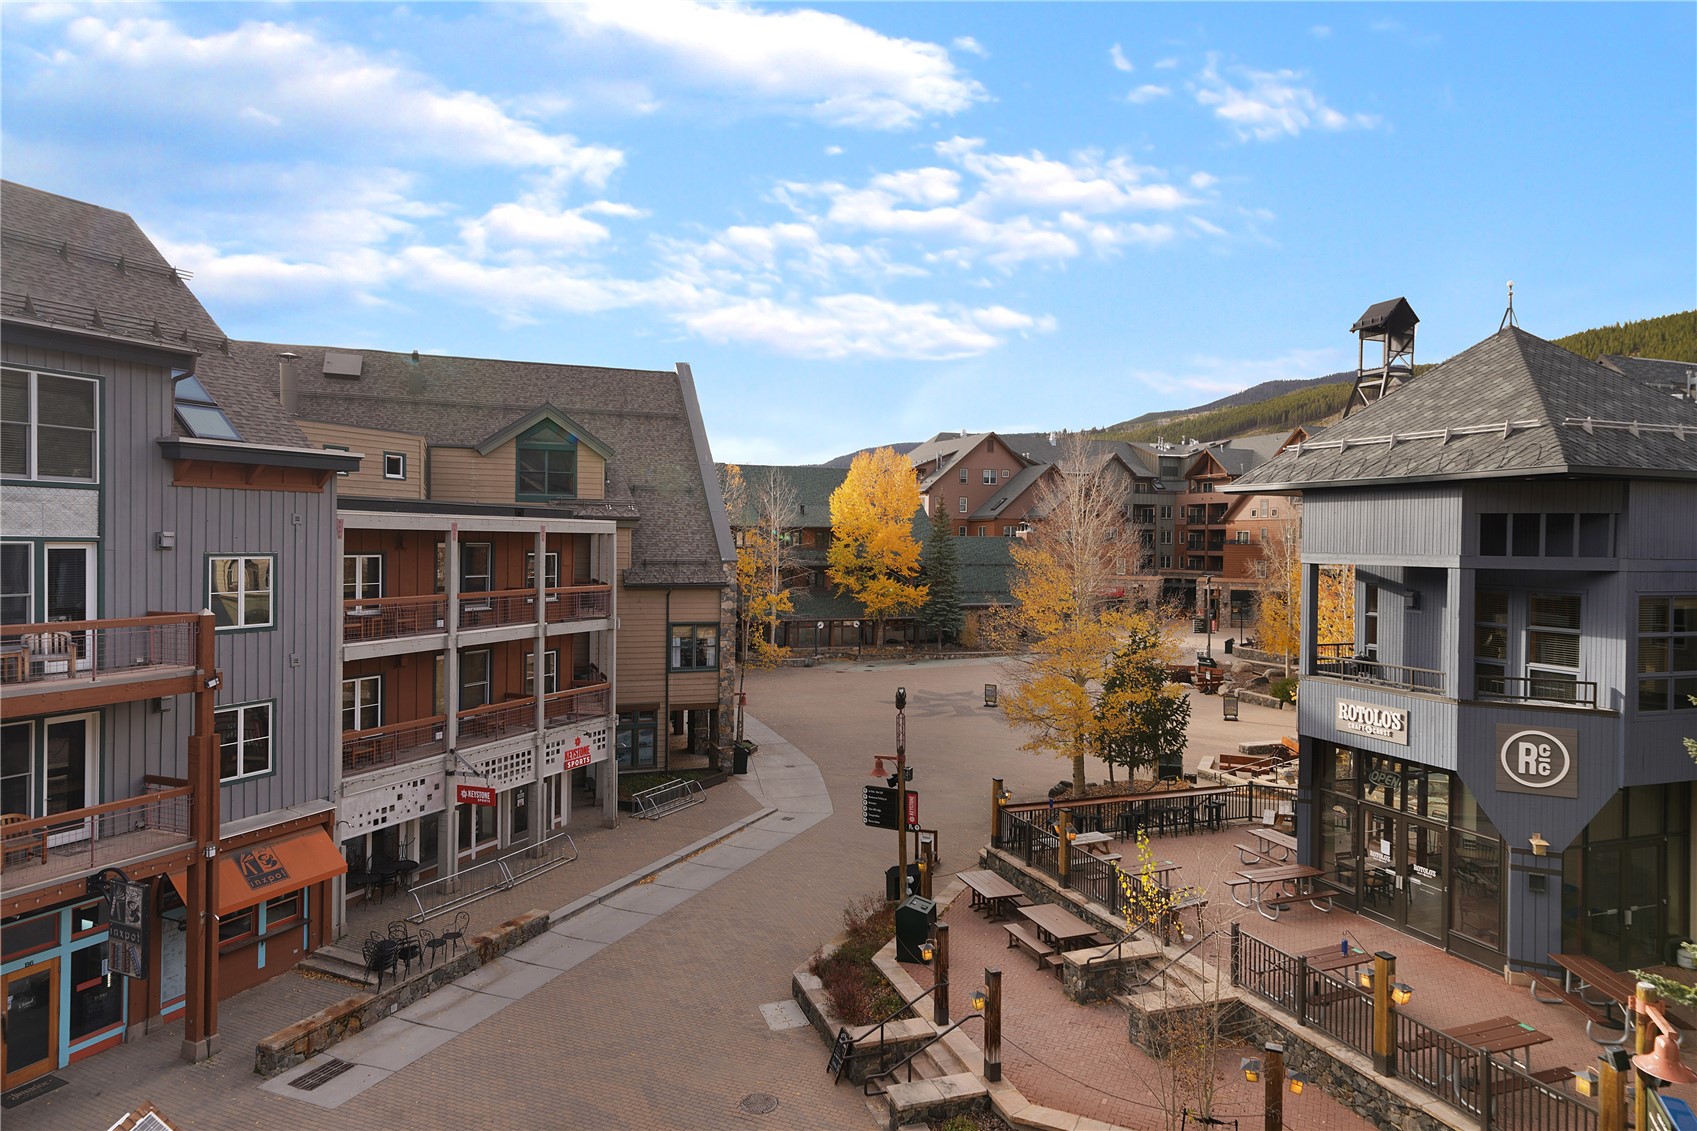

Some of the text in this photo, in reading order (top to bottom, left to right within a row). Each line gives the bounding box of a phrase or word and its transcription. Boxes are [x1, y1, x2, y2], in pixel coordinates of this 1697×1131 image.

[1338, 702, 1402, 731] ROTOLO'S
[1348, 722, 1365, 732] CRAFT
[564, 745, 591, 761] KEYSTONE
[567, 756, 591, 769] SPORTS
[1371, 770, 1400, 787] OPEN
[467, 790, 491, 800] KEYSTONE
[247, 869, 287, 888] inxpot
[109, 923, 141, 943] inxpot
